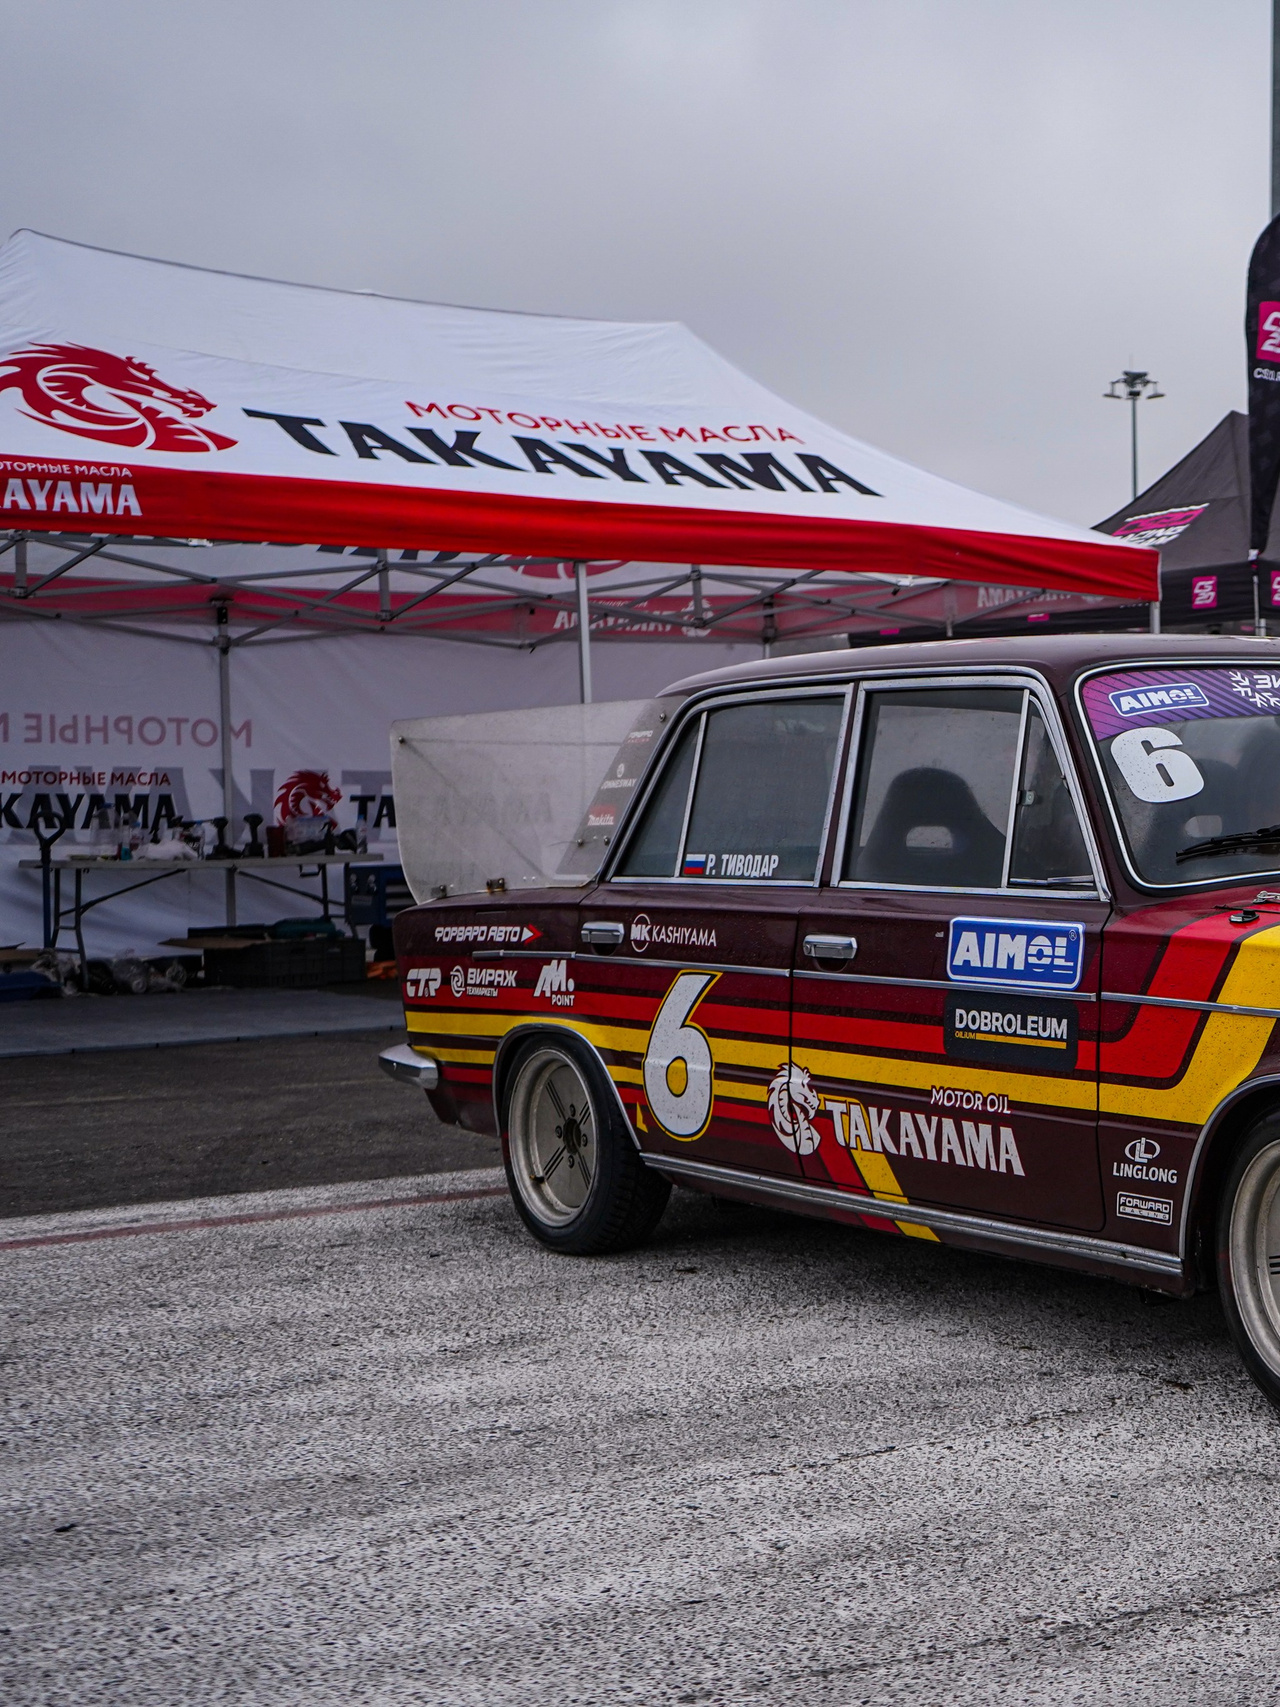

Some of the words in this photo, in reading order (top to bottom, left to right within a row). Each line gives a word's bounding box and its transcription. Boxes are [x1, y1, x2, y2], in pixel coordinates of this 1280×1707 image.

[404, 400, 656, 442] МОТОРНЫЕ
[658, 424, 805, 445] МАСЛА
[242, 407, 884, 498] TAKAYAMA
[0, 460, 71, 475] ТОРНЫЕ
[75, 464, 133, 478] МАСЛА
[1120, 688, 1204, 712] AIMOL
[1111, 727, 1205, 803] 6
[1, 771, 106, 786] МОТОРНЫЕ
[110, 772, 171, 787] МАСЛА
[706, 853, 716, 875] Р.
[721, 854, 779, 878] ТИВОДАР
[434, 926, 486, 942] ФОРВАРД
[487, 926, 521, 942] АВТО
[652, 922, 717, 947] KASHIYAMA
[952, 931, 1074, 974] AIMOL
[466, 967, 518, 988] ВИРАЖ
[466, 986, 498, 997] ТЕХМАРКЕТЫ
[552, 994, 575, 1007] POINT
[954, 1008, 1068, 1039] DOBROLEUM
[643, 969, 723, 1140] 6
[930, 1087, 983, 1111] MOTOR
[987, 1094, 1012, 1114] OIL
[825, 1099, 1026, 1177] TAKAYAMA
[1112, 1162, 1178, 1184] LINGLONG
[1120, 1196, 1170, 1213] FORWARD
[1121, 1206, 1169, 1220] RACING
